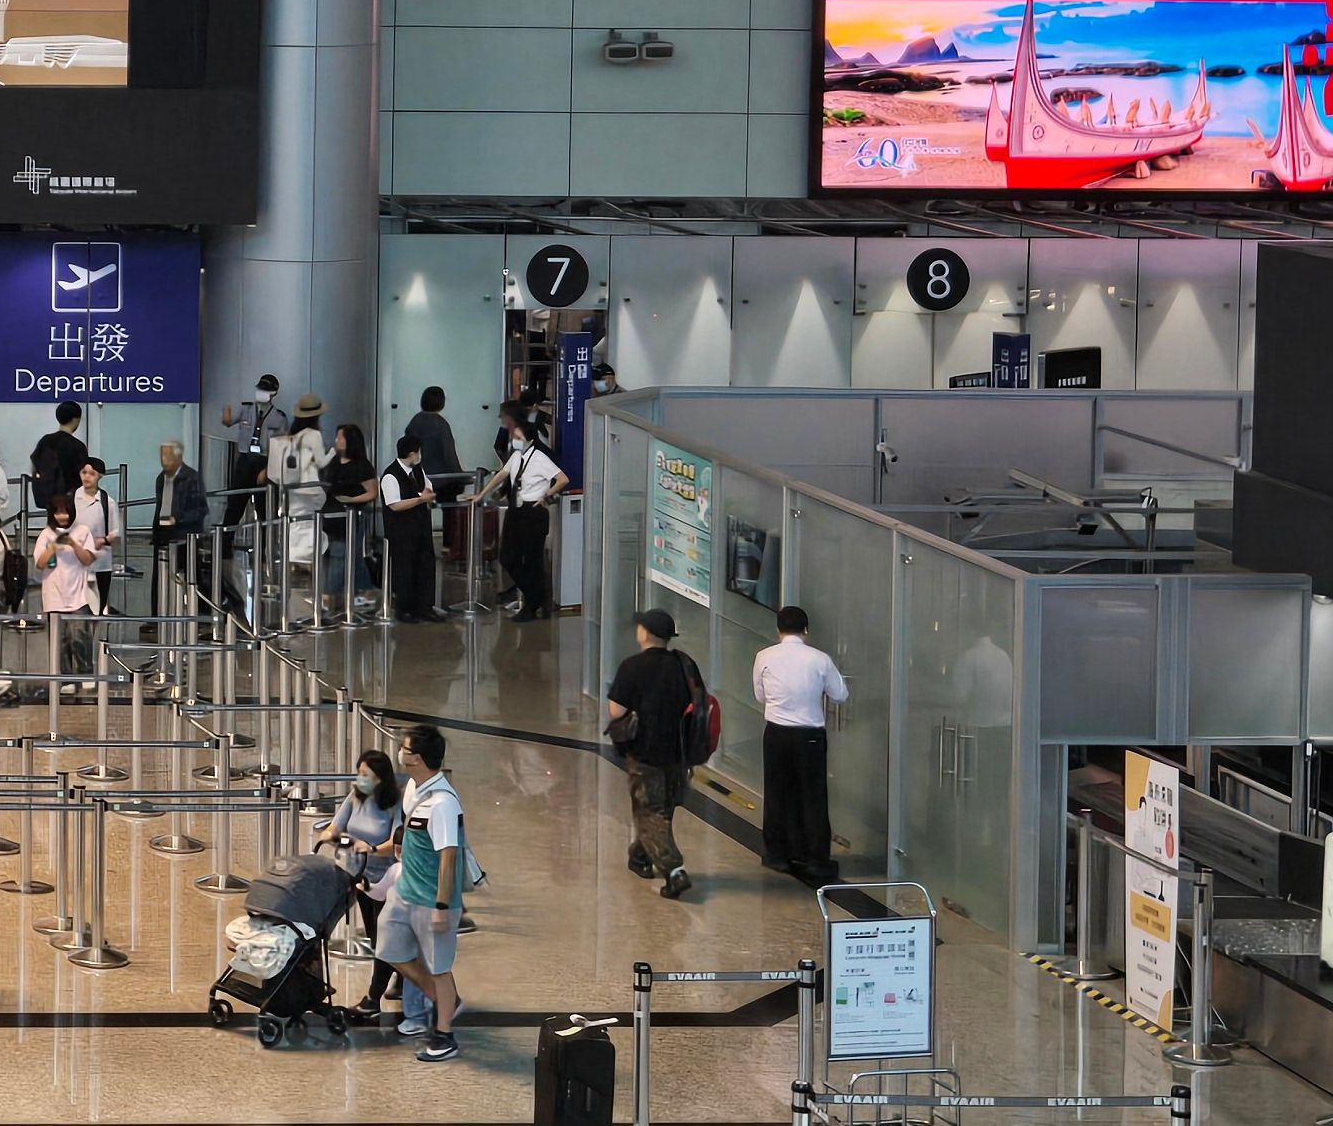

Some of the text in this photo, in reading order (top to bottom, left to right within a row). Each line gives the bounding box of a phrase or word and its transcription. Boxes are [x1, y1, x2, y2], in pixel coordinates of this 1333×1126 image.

[547, 257, 571, 296] 7
[926, 259, 952, 300] 8
[47, 323, 130, 362] 出發
[14, 368, 165, 399] Departures
